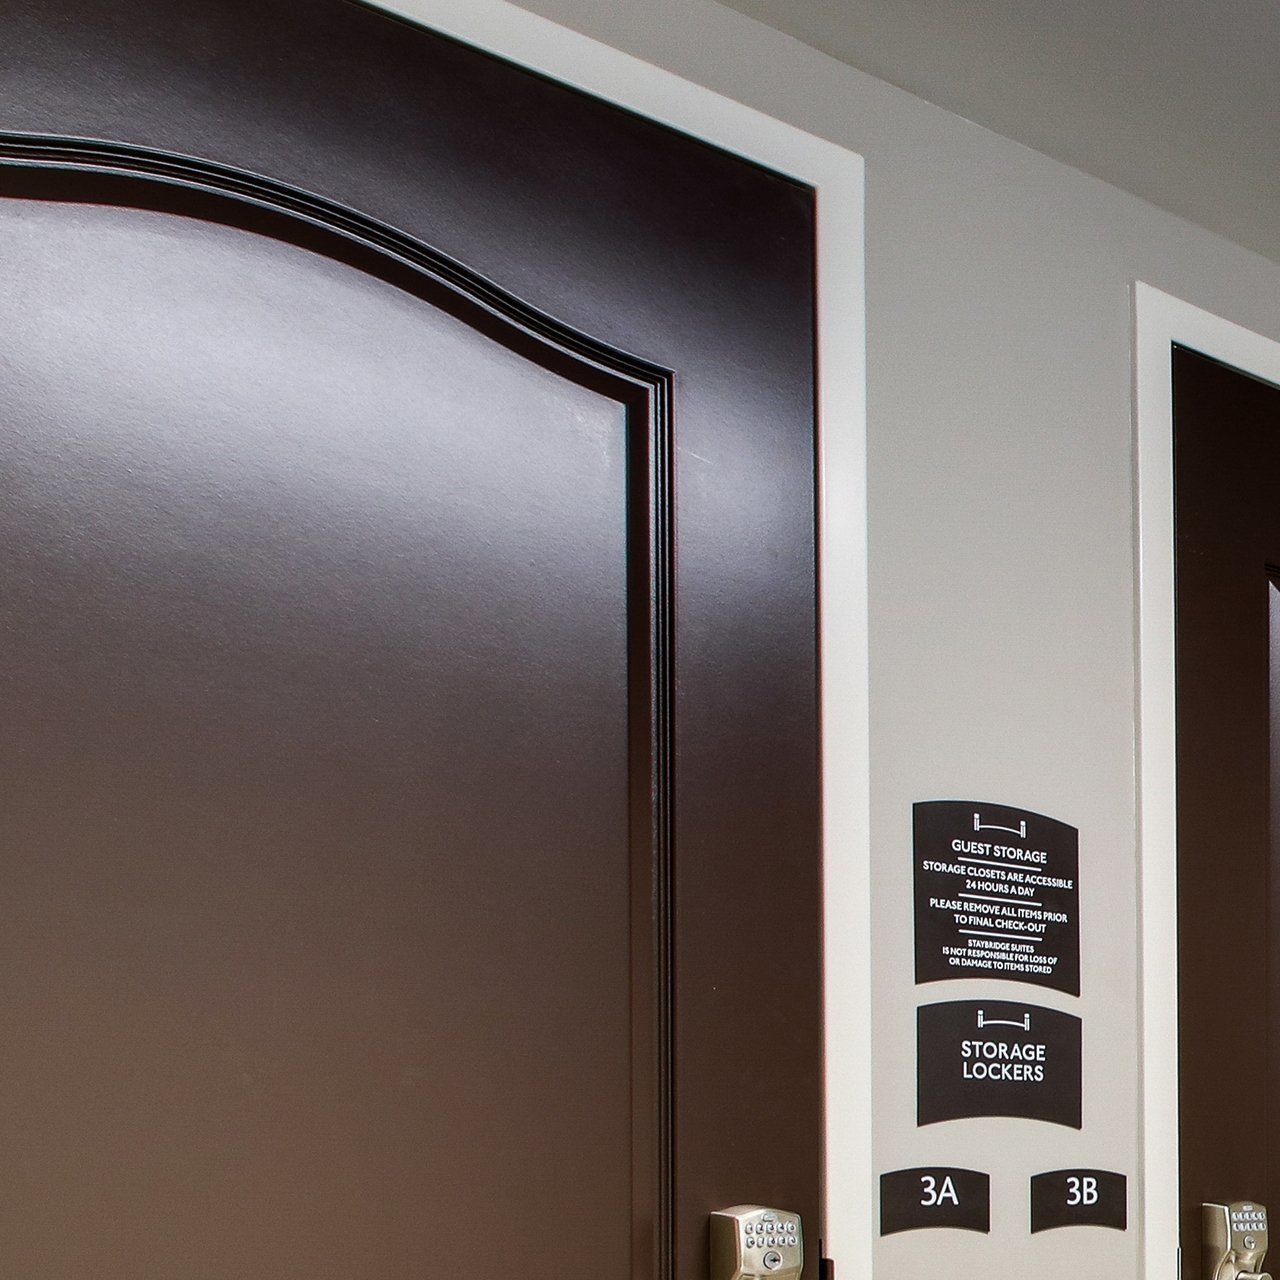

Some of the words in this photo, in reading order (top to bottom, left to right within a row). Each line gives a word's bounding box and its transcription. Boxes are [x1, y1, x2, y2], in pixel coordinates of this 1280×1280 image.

[952, 840, 991, 856] GUEST
[994, 846, 1047, 864] STORAGE
[923, 860, 966, 874] STORAGE
[967, 867, 1006, 880] CLOSETS
[1007, 873, 1023, 883] ARE
[1025, 875, 1073, 889] ACCESSIBLE
[966, 880, 976, 889] 24
[978, 881, 1009, 893] HOURS
[1010, 886, 1017, 894] A
[1018, 887, 1035, 897] DAY
[930, 898, 962, 910] PLEASE
[964, 903, 1000, 915] REMOVE
[1001, 907, 1016, 917] ALL
[1018, 910, 1042, 919] ITEMS
[1044, 912, 1068, 923] PRIOR
[954, 914, 967, 924] TO
[969, 916, 993, 927] FINAL
[995, 919, 1046, 933] CHECK-OUT
[950, 947, 966, 956] NOT
[968, 950, 1014, 961] RESPONSIBLE
[1015, 954, 1029, 962] FOR
[1030, 956, 1047, 964] LOSS
[1048, 957, 1058, 965] OF
[968, 940, 1010, 951] STAYBRIDGE
[1011, 944, 1034, 953] SUITES
[949, 958, 960, 966] OR
[961, 958, 992, 969] DAMAGE
[993, 961, 1003, 969] TO
[1004, 962, 1024, 971] ITEMS
[1025, 964, 1052, 974] STORED
[961, 1040, 1046, 1062] STORAGE
[963, 1061, 1044, 1082] LOCKERS
[920, 1176, 960, 1206] 3A
[1066, 1176, 1099, 1206] 3B
